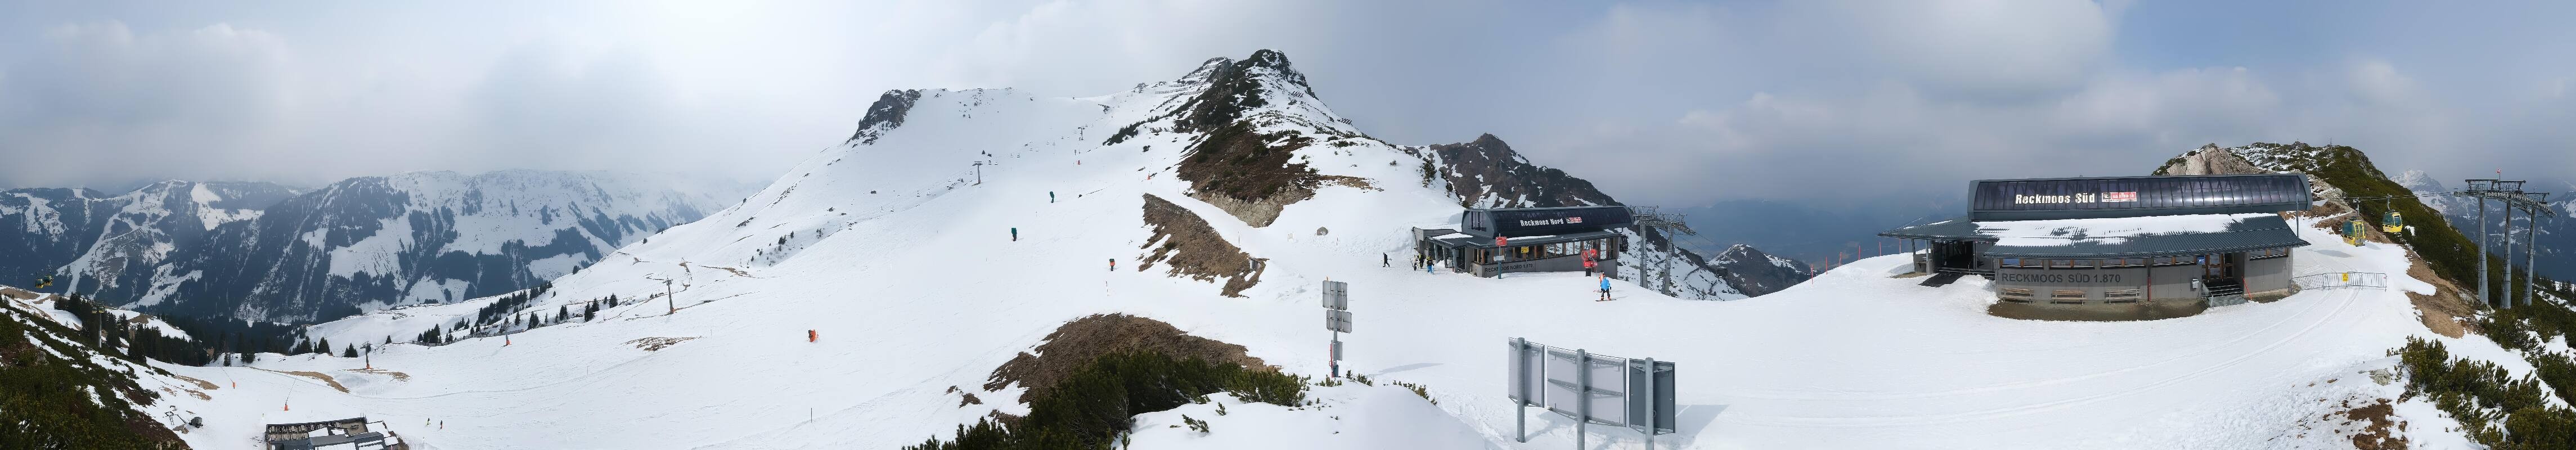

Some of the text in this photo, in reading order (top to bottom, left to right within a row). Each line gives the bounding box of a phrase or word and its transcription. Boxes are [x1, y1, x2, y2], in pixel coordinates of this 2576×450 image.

[2015, 192, 2095, 204] Reckmoos Süd
[2002, 273, 2121, 282] RECKMOOS SÜD 1.870
